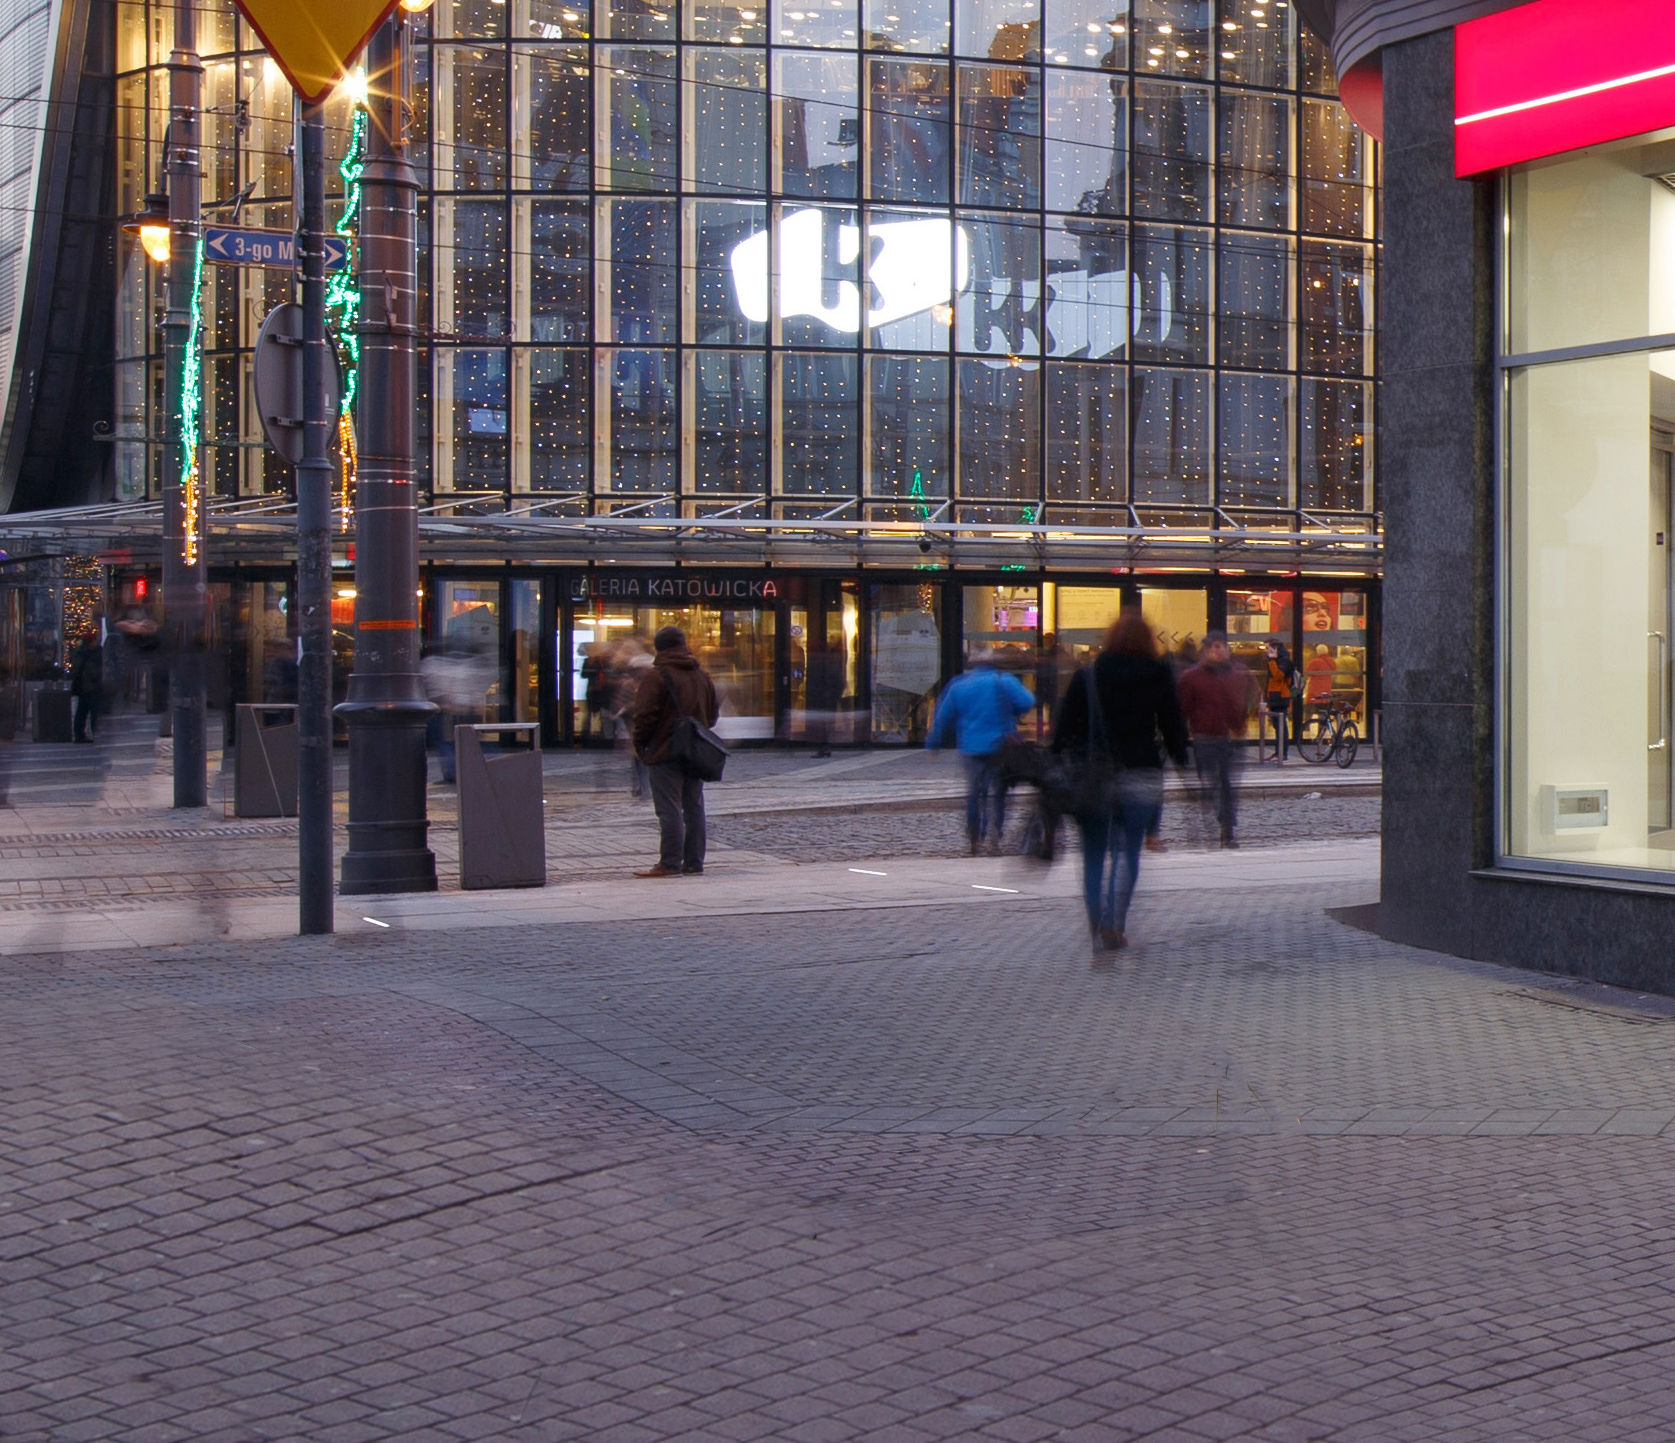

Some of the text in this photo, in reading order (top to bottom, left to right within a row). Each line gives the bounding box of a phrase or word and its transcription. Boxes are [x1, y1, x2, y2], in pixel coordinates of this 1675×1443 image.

[235, 237, 272, 262] 3-go
[570, 578, 777, 597] GALERIA KATOWICKA
